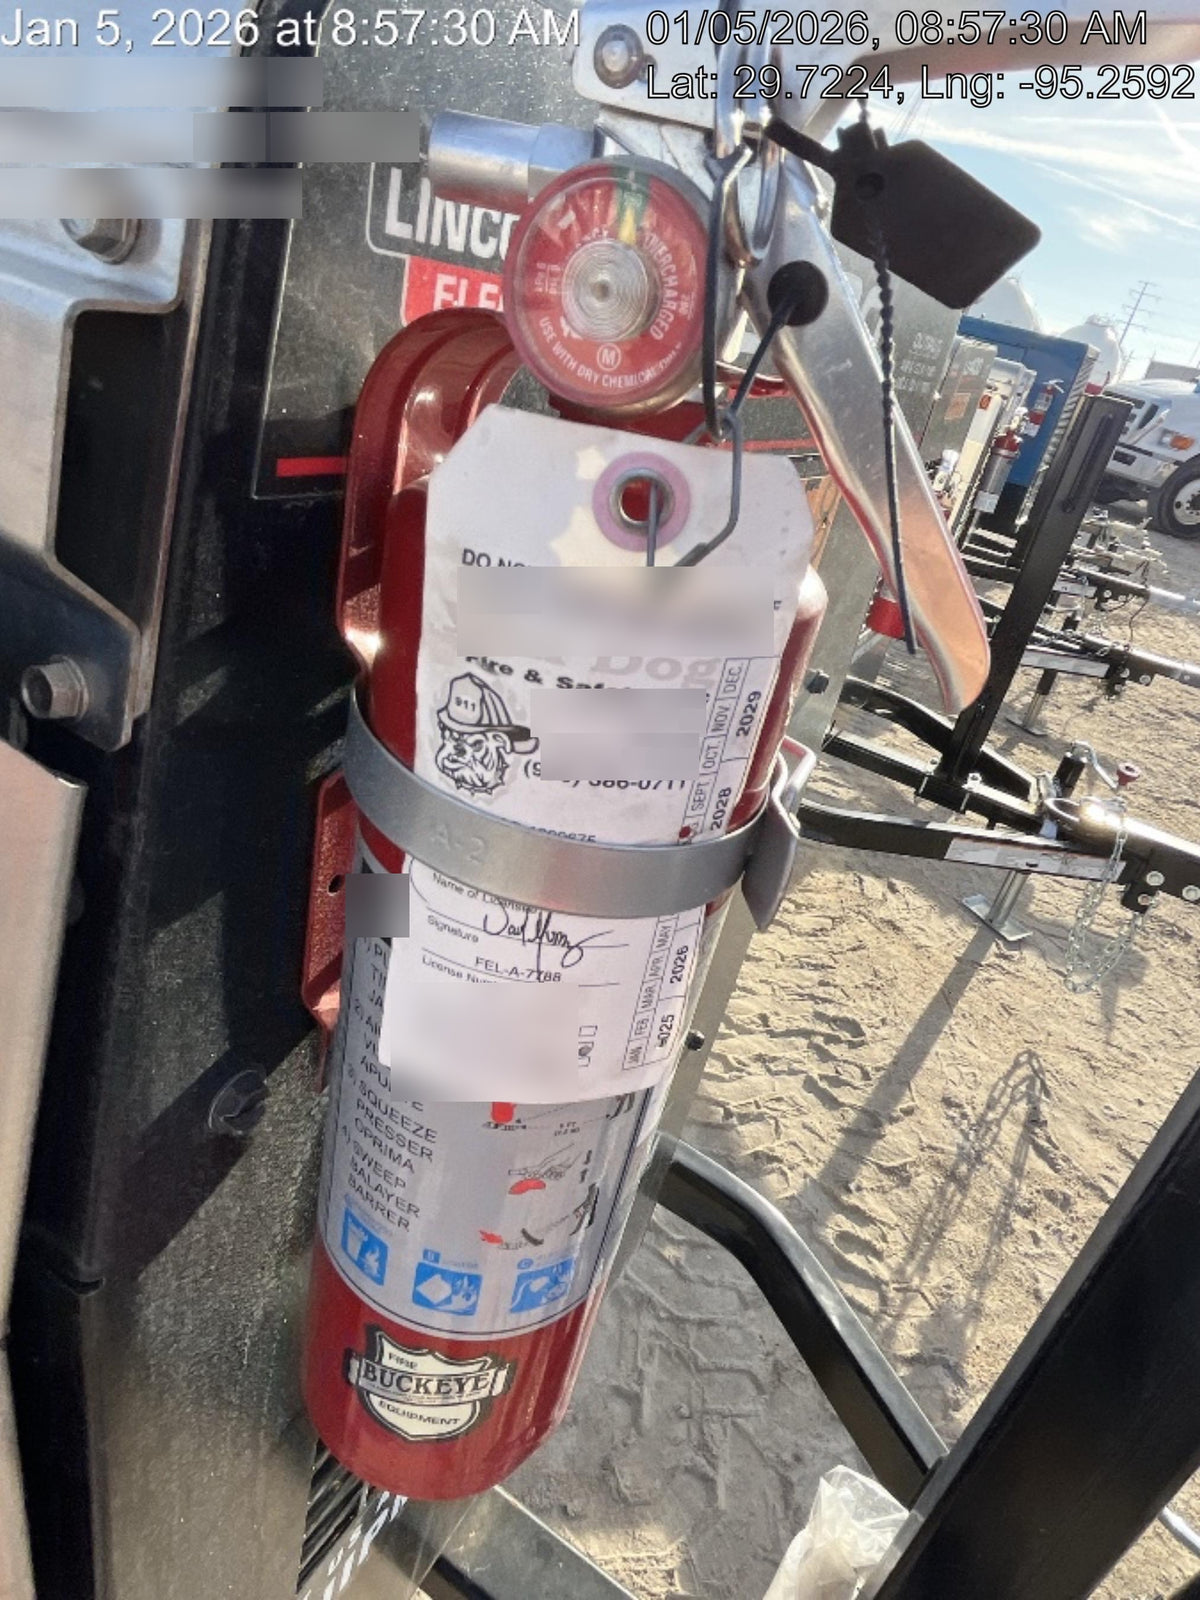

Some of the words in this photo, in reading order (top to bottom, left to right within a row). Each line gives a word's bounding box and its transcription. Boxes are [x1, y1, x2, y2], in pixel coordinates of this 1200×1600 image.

[540, 317, 558, 343] USE
[552, 341, 578, 370] WITH
[577, 364, 600, 385] DRY
[455, 695, 477, 713] 911
[736, 691, 762, 737] 2029
[710, 787, 732, 831] 2028
[433, 872, 465, 896] Name
[427, 914, 480, 943] Signature
[421, 956, 463, 979] License
[669, 945, 689, 984] 2026
[356, 1098, 434, 1163] PRESSER
[358, 1080, 438, 1144] SQUEEZE
[352, 1140, 407, 1189] SWEEP
[354, 1117, 416, 1174] OPRIMA
[348, 1173, 411, 1233] BARRER
[351, 1156, 421, 1218] BALAYER
[362, 1362, 491, 1396] BUCKEYE
[378, 1399, 461, 1426] EQUIPMENT
